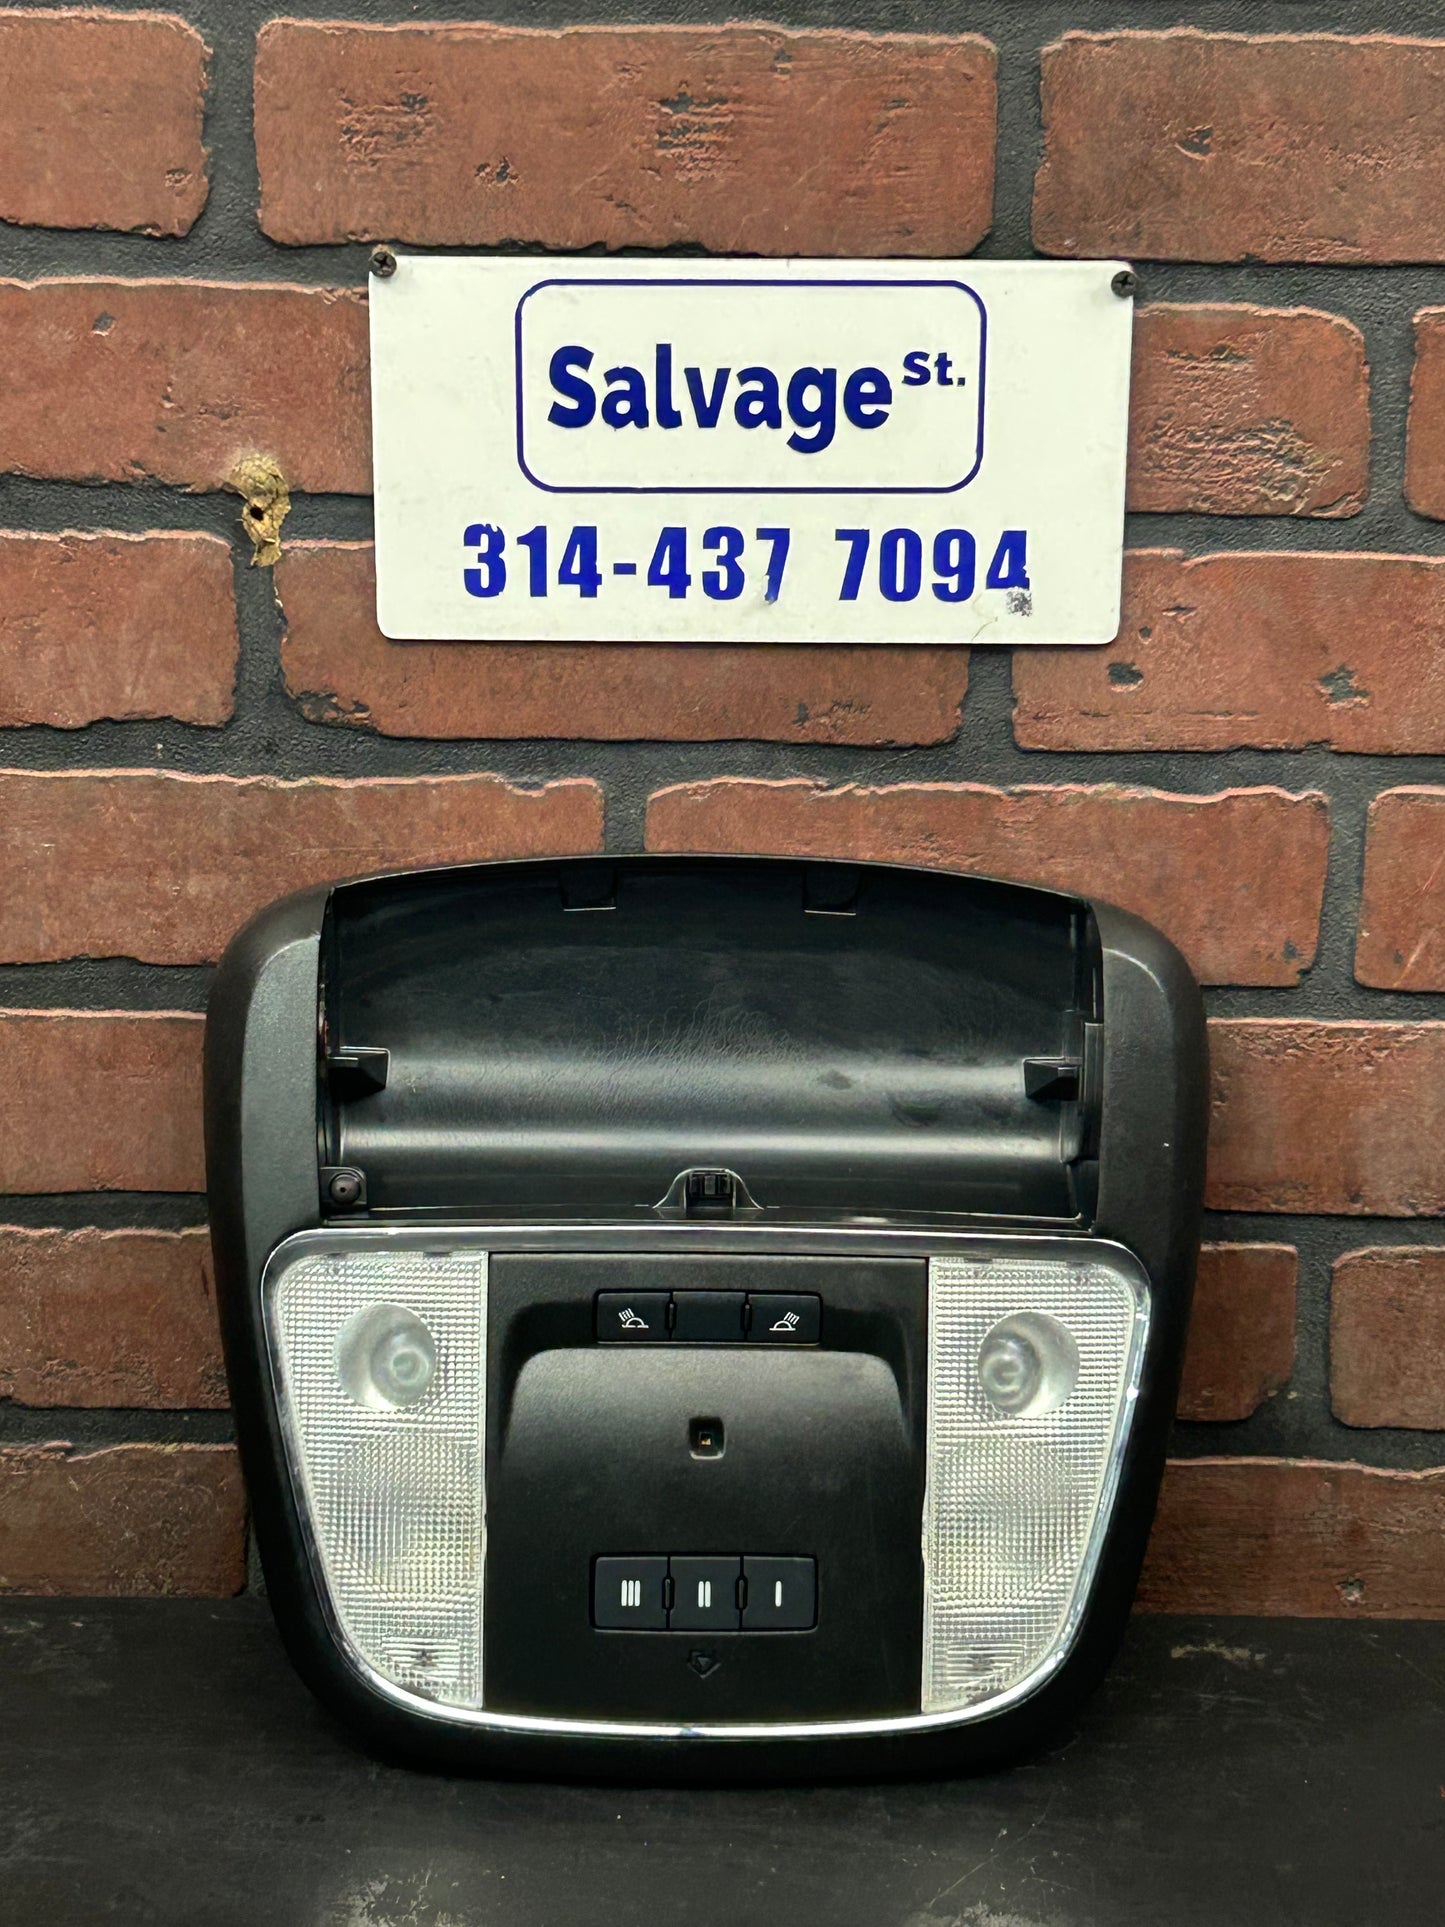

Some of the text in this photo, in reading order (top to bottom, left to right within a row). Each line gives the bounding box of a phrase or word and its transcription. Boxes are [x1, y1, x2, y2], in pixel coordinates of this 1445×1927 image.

[547, 343, 966, 453] Salvage St.
[463, 523, 1030, 604] 314-437 7094
